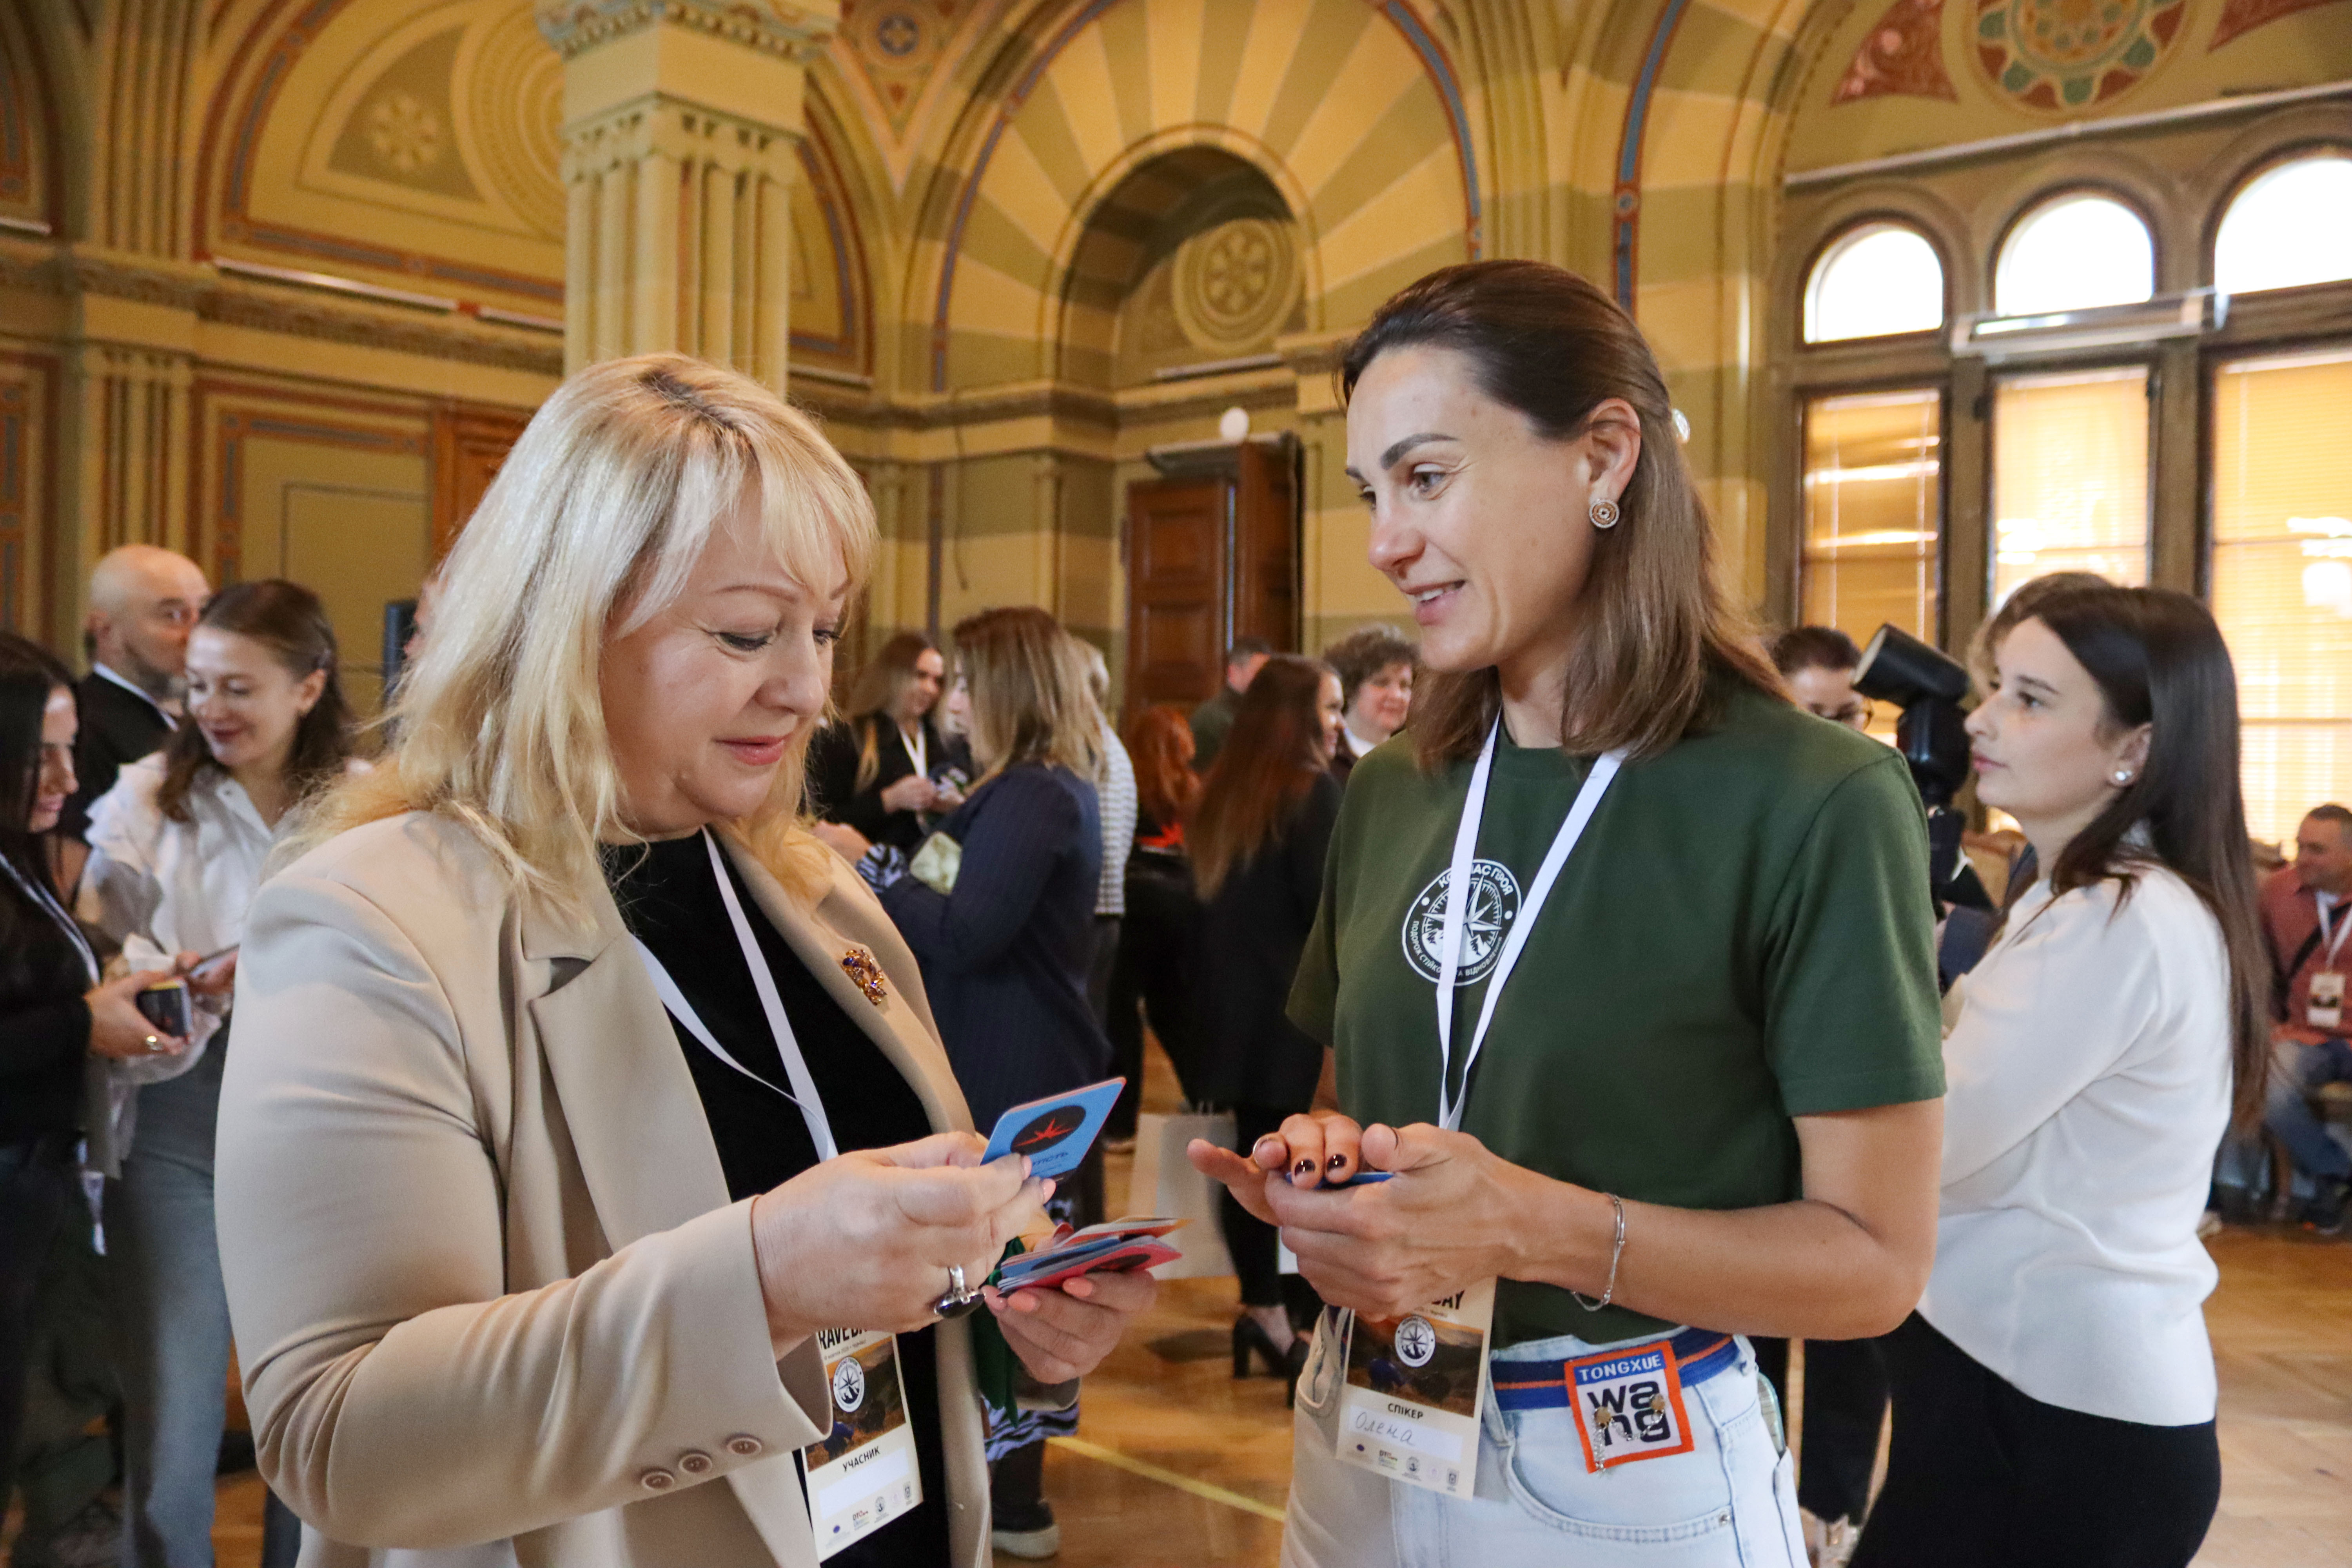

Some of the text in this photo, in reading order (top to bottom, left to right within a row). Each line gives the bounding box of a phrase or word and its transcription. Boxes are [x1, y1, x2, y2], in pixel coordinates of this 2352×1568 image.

[1491, 867, 1514, 896] ГЕРОЯ
[1410, 920, 1423, 956] ПОДОРОЖ
[1419, 954, 1442, 973] СТІЙКО
[1579, 1354, 1662, 1382] TONGXUE
[1388, 1403, 1424, 1419] СПІКЕР
[1355, 1412, 1416, 1446] Олена
[843, 1445, 880, 1472] УЧАСНИК
